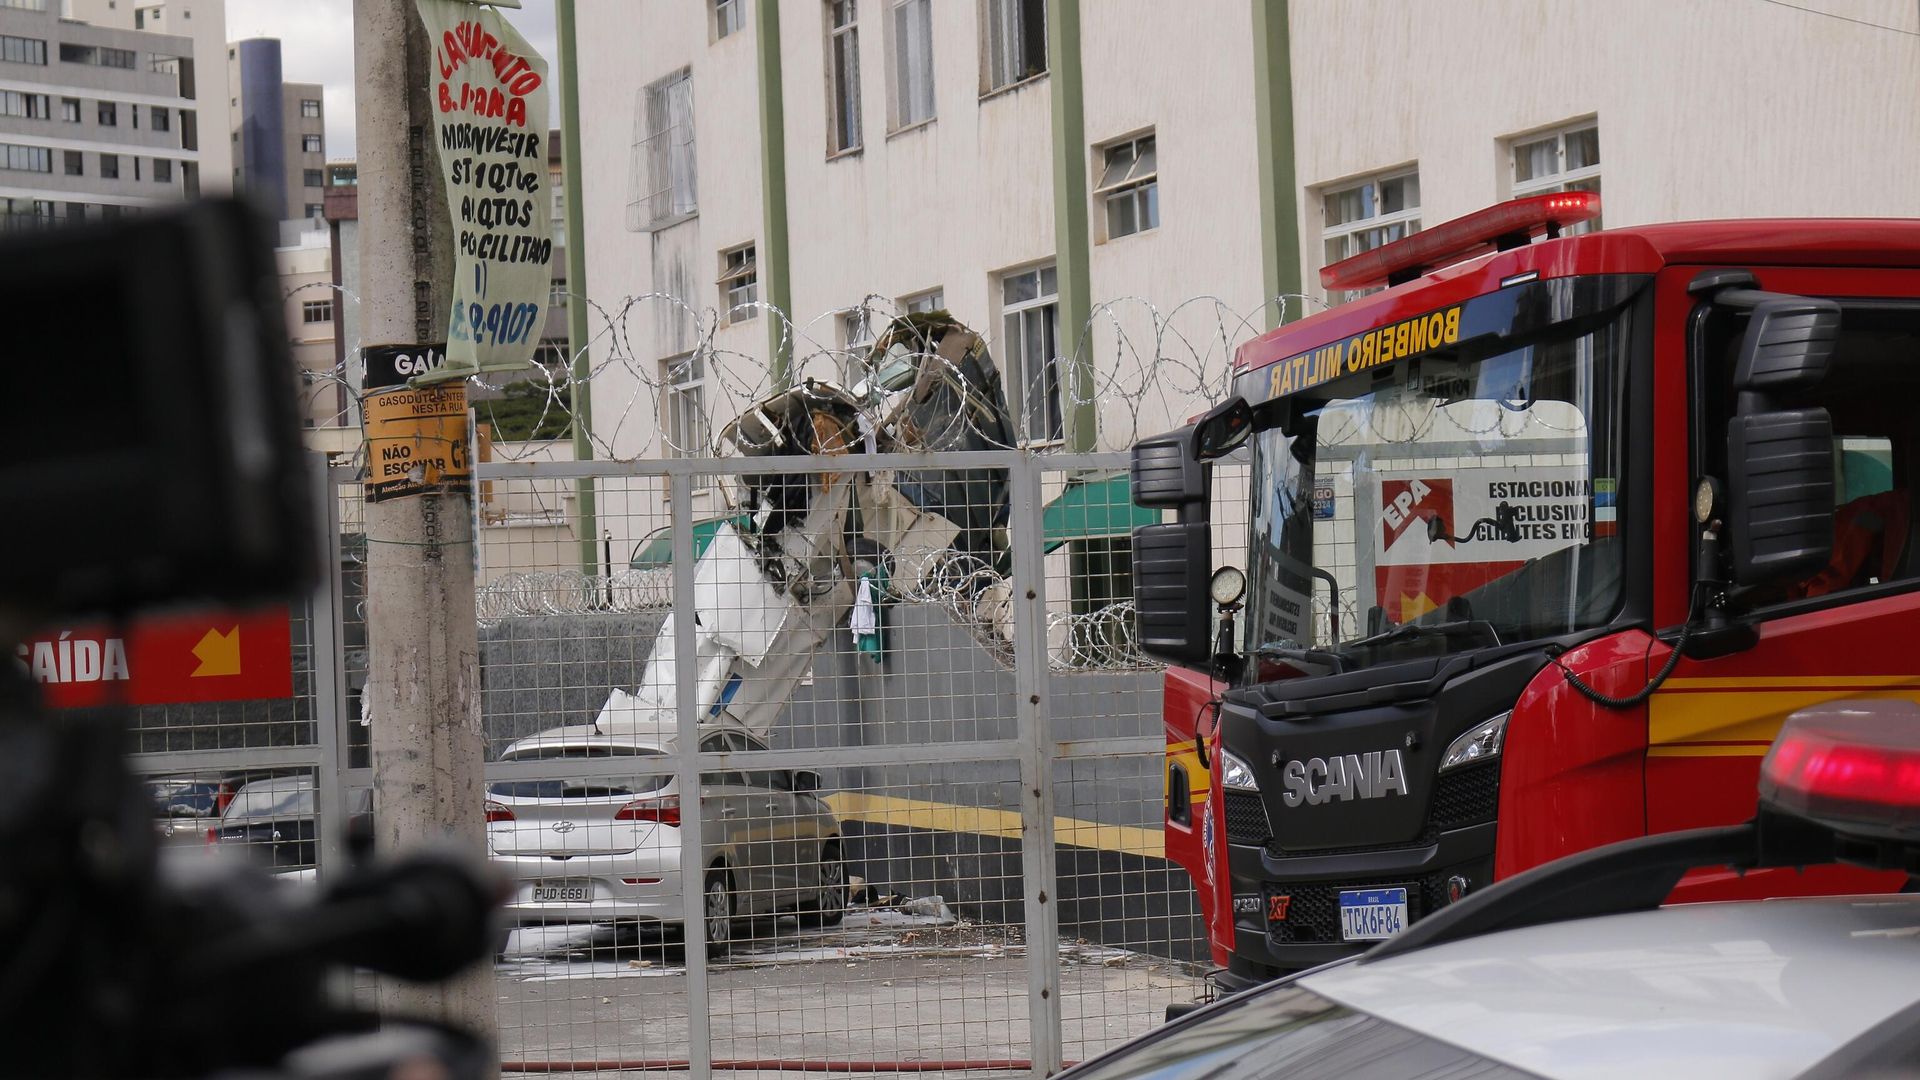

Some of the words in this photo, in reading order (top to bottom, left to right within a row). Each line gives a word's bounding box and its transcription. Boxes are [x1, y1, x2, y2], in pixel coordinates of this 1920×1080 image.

[441, 391, 466, 402] ENTER
[412, 402, 447, 415] NESTA
[449, 401, 464, 413] RUA
[382, 443, 411, 461] NÃO
[1382, 479, 1432, 531] EPA
[1495, 504, 1587, 521] ECLUSIVO
[1282, 748, 1409, 808] SCANIA
[1346, 905, 1401, 935] TCK6F84
